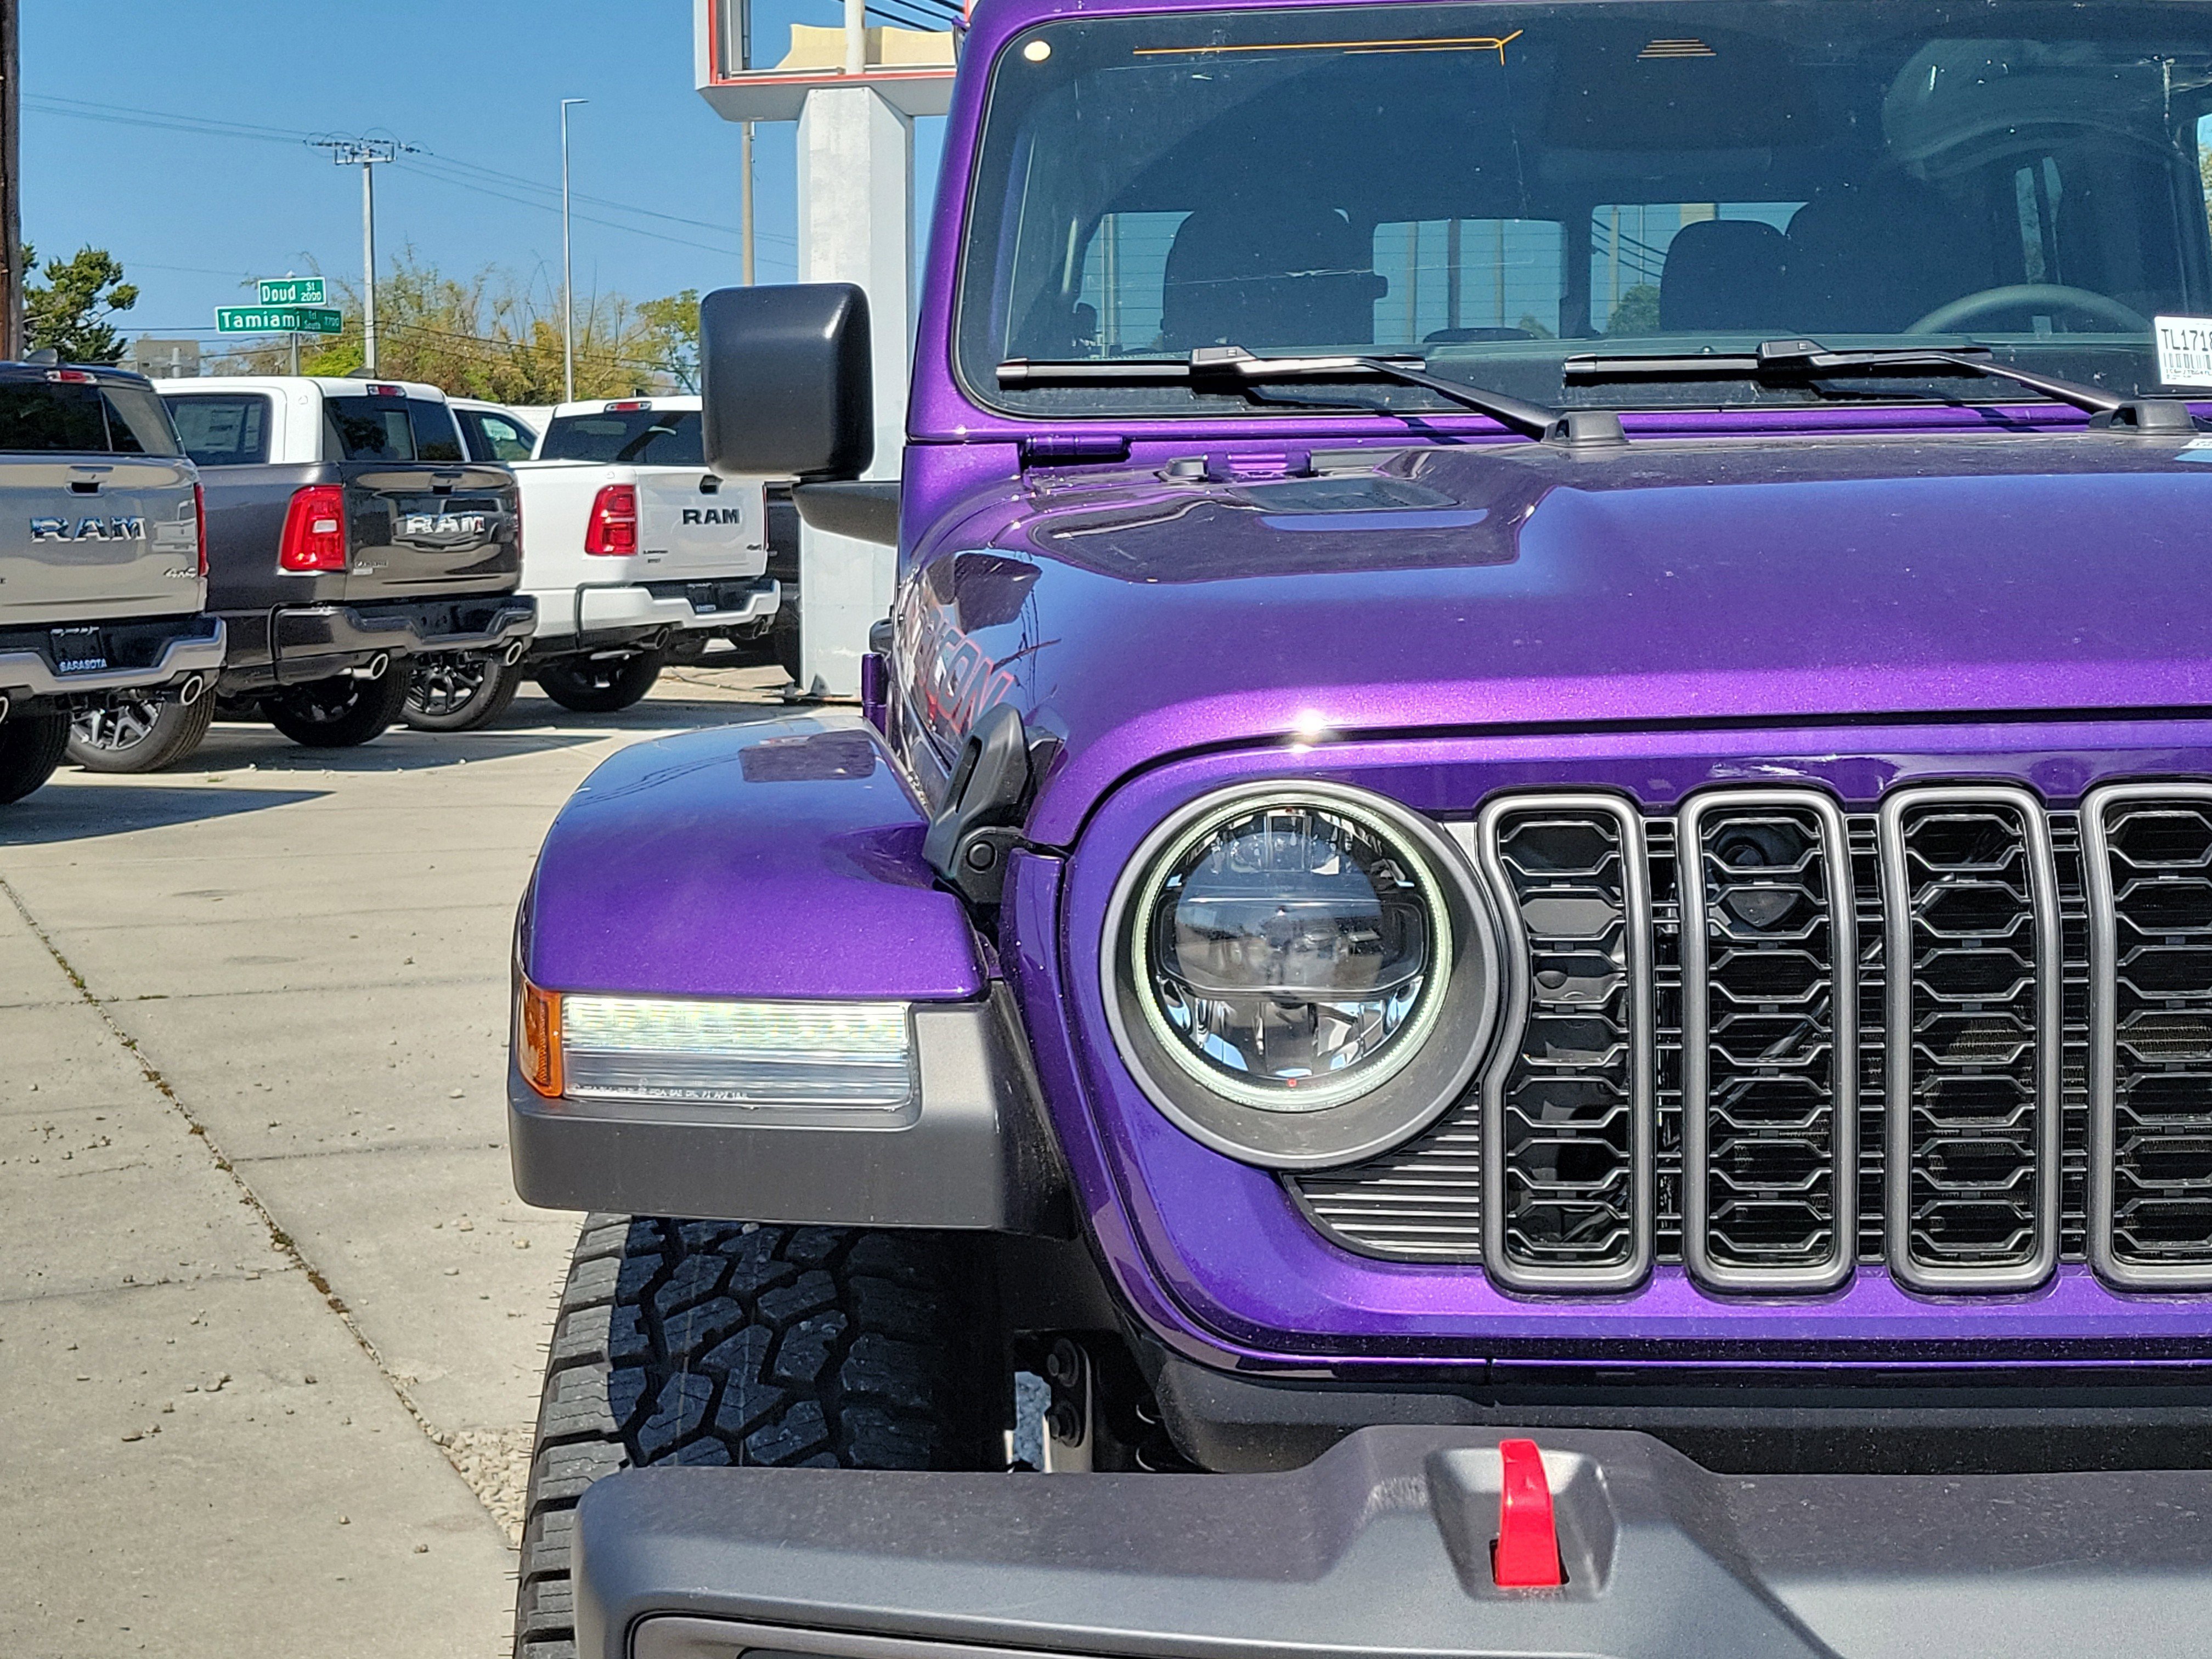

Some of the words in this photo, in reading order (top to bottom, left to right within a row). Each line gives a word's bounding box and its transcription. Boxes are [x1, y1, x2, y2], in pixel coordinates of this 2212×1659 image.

[261, 284, 297, 302] Doud
[300, 292, 322, 302] 2000
[221, 311, 301, 329] Tamiami
[405, 511, 486, 534] RAM
[682, 509, 741, 525] RAM
[30, 516, 146, 543] RAM
[59, 658, 108, 672] SARASOTA
